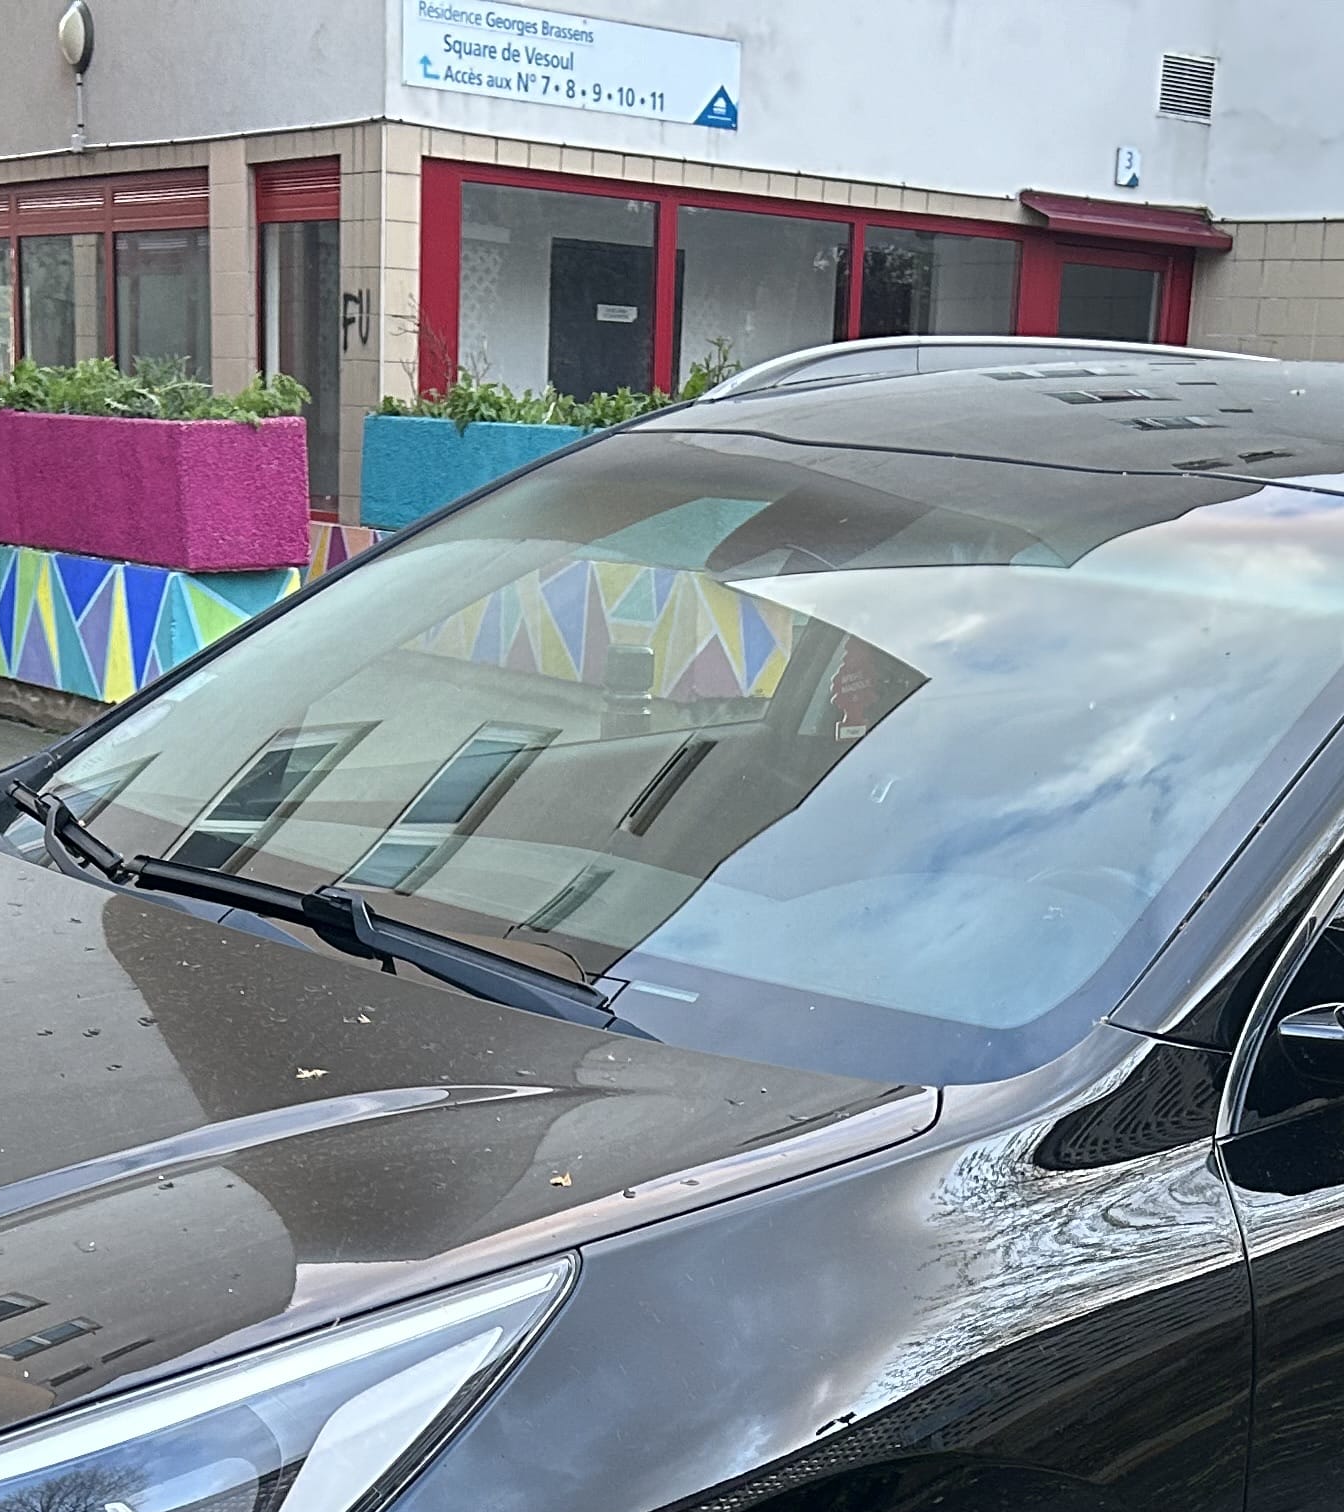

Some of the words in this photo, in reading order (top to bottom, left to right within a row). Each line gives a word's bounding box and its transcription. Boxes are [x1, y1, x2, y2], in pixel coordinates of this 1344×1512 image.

[418, 0, 483, 27] Résidence
[485, 11, 538, 36] Georges
[541, 20, 594, 43] Brassens
[443, 33, 497, 60] Square
[501, 42, 521, 63] de
[524, 46, 574, 71] Vesoul
[444, 65, 482, 86] Accès
[486, 75, 512, 91] aux
[517, 71, 537, 93] N°
[541, 75, 550, 95] 7
[566, 79, 576, 99] 8
[592, 83, 602, 102] 9
[617, 87, 635, 107] 10
[650, 91, 665, 112] 11
[1125, 151, 1134, 170] 3
